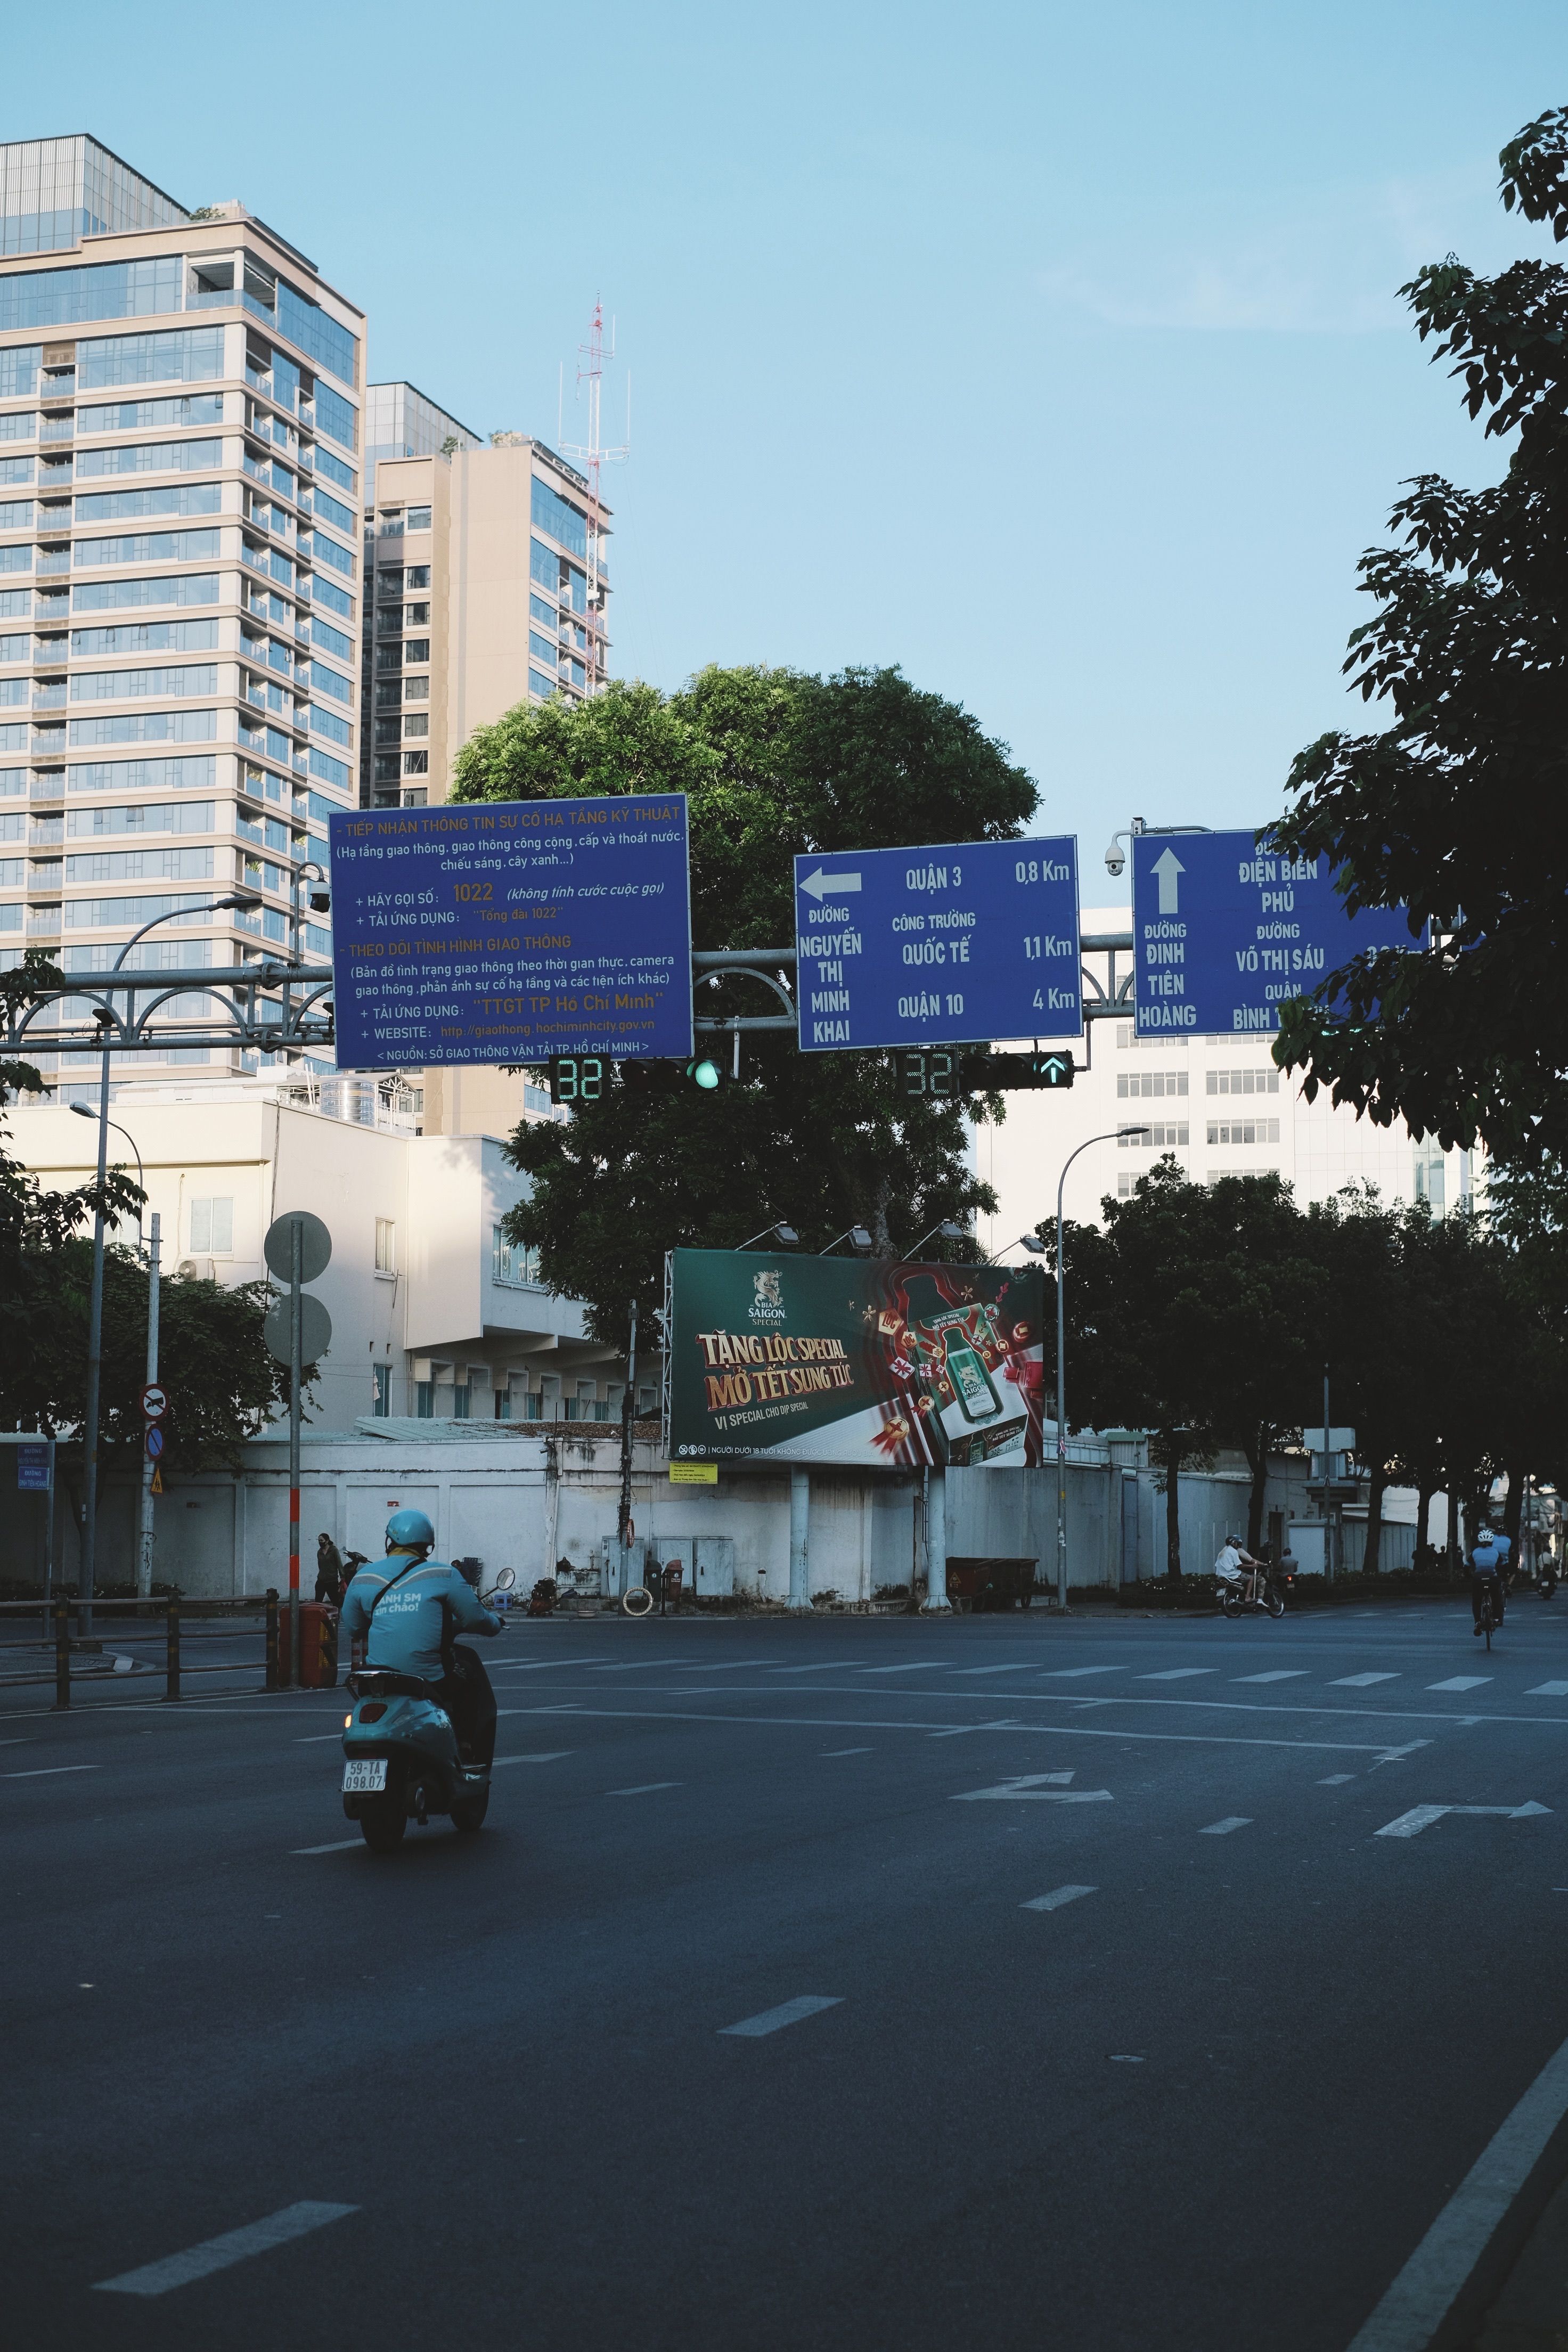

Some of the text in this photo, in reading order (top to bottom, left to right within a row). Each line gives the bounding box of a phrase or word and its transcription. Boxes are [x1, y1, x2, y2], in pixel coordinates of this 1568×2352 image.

[346, 804, 680, 837] TIẾP NHẬN THÔNG TIN SỰ CỐ HẠ TẦNG KỸ THUẬT
[337, 847, 356, 860] (Hạ
[360, 844, 382, 859] tầng
[387, 846, 409, 858] giao
[452, 843, 475, 854] giao
[478, 839, 510, 852] thông
[514, 838, 541, 850] công
[602, 833, 615, 844] và
[619, 831, 647, 844] thoát
[441, 856, 471, 870] chiếu
[509, 856, 527, 869] cây
[1239, 855, 1317, 887] ĐIỆN BIÊN
[907, 860, 1069, 894] QUẬN 3 0,8 Km
[368, 893, 391, 906] HÃY
[395, 894, 414, 907] GỌI
[454, 883, 493, 902] 1022
[508, 888, 548, 901] (không
[552, 886, 574, 897] tính
[578, 884, 608, 896] cước
[610, 884, 639, 896] cuộc
[642, 883, 664, 896] gọi)
[1262, 883, 1294, 912] PHỦ
[369, 911, 387, 926] TẢI
[391, 911, 416, 925] ỨNG
[809, 904, 849, 923] ĐƯỜNG
[893, 909, 975, 932] CÔNG TRƯỜNG
[1145, 920, 1186, 938] ĐƯỜNG
[1257, 921, 1300, 939] ĐƯỜNG
[349, 934, 571, 957] THEO DÕI TÌNH HÌNH GIAO THÔNG
[800, 927, 861, 957] NGUYỄN
[903, 935, 1072, 965] QUỐC TẾ 1,1 Km
[1147, 943, 1184, 964] ĐINH
[351, 957, 674, 978] (Bản đồ tình trạng giao thông theo thời gian camera
[1236, 944, 1324, 975] VÕ THỊ SÁU
[356, 987, 378, 998] giao
[452, 980, 471, 991] ánh
[475, 981, 489, 993] sự
[493, 976, 507, 990] cố
[510, 978, 522, 991] hạ
[526, 976, 550, 990] tầng
[554, 976, 567, 987] và
[571, 975, 589, 986] các
[593, 975, 613, 988] tiện
[618, 974, 634, 985] ích
[639, 971, 669, 984] khác)
[818, 961, 842, 986] THỊ
[1148, 970, 1184, 995] TIÊN
[373, 1004, 391, 1019] TẢI
[395, 1004, 420, 1018] ỨNG
[529, 997, 550, 1012] TP
[556, 996, 577, 1011] Hồ
[584, 994, 609, 1010] Chí
[812, 990, 849, 1012] MINH
[899, 988, 1074, 1022] QUẬN 10 4 Km
[1139, 1001, 1196, 1027] HOÀNG
[1234, 1004, 1270, 1029] BÌNH
[374, 1027, 431, 1039] WEBSITE:
[814, 1020, 850, 1042] KHAI
[387, 1040, 639, 1060] NGUỒN: SỞ GIAO THÔNG VẬN TẢI CHÍ MINH
[559, 1060, 602, 1099] 32
[907, 1054, 951, 1094] 32
[748, 1308, 785, 1318] SAIGON
[696, 1329, 847, 1370] TẶNG LỘC SPECIAL
[704, 1361, 854, 1411] MỞ TẾT SUNG TÚC
[962, 1384, 988, 1396] SAIGON
[715, 1416, 728, 1430] VỊ
[730, 1409, 766, 1426] SPECIAL
[766, 1407, 779, 1418] CHO
[790, 1402, 808, 1413] SPECIAL
[377, 1593, 421, 1606] ANH SM
[389, 1603, 419, 1613] chào!
[350, 1761, 380, 1775] 59-TA
[346, 1775, 382, 1789] 098.07
